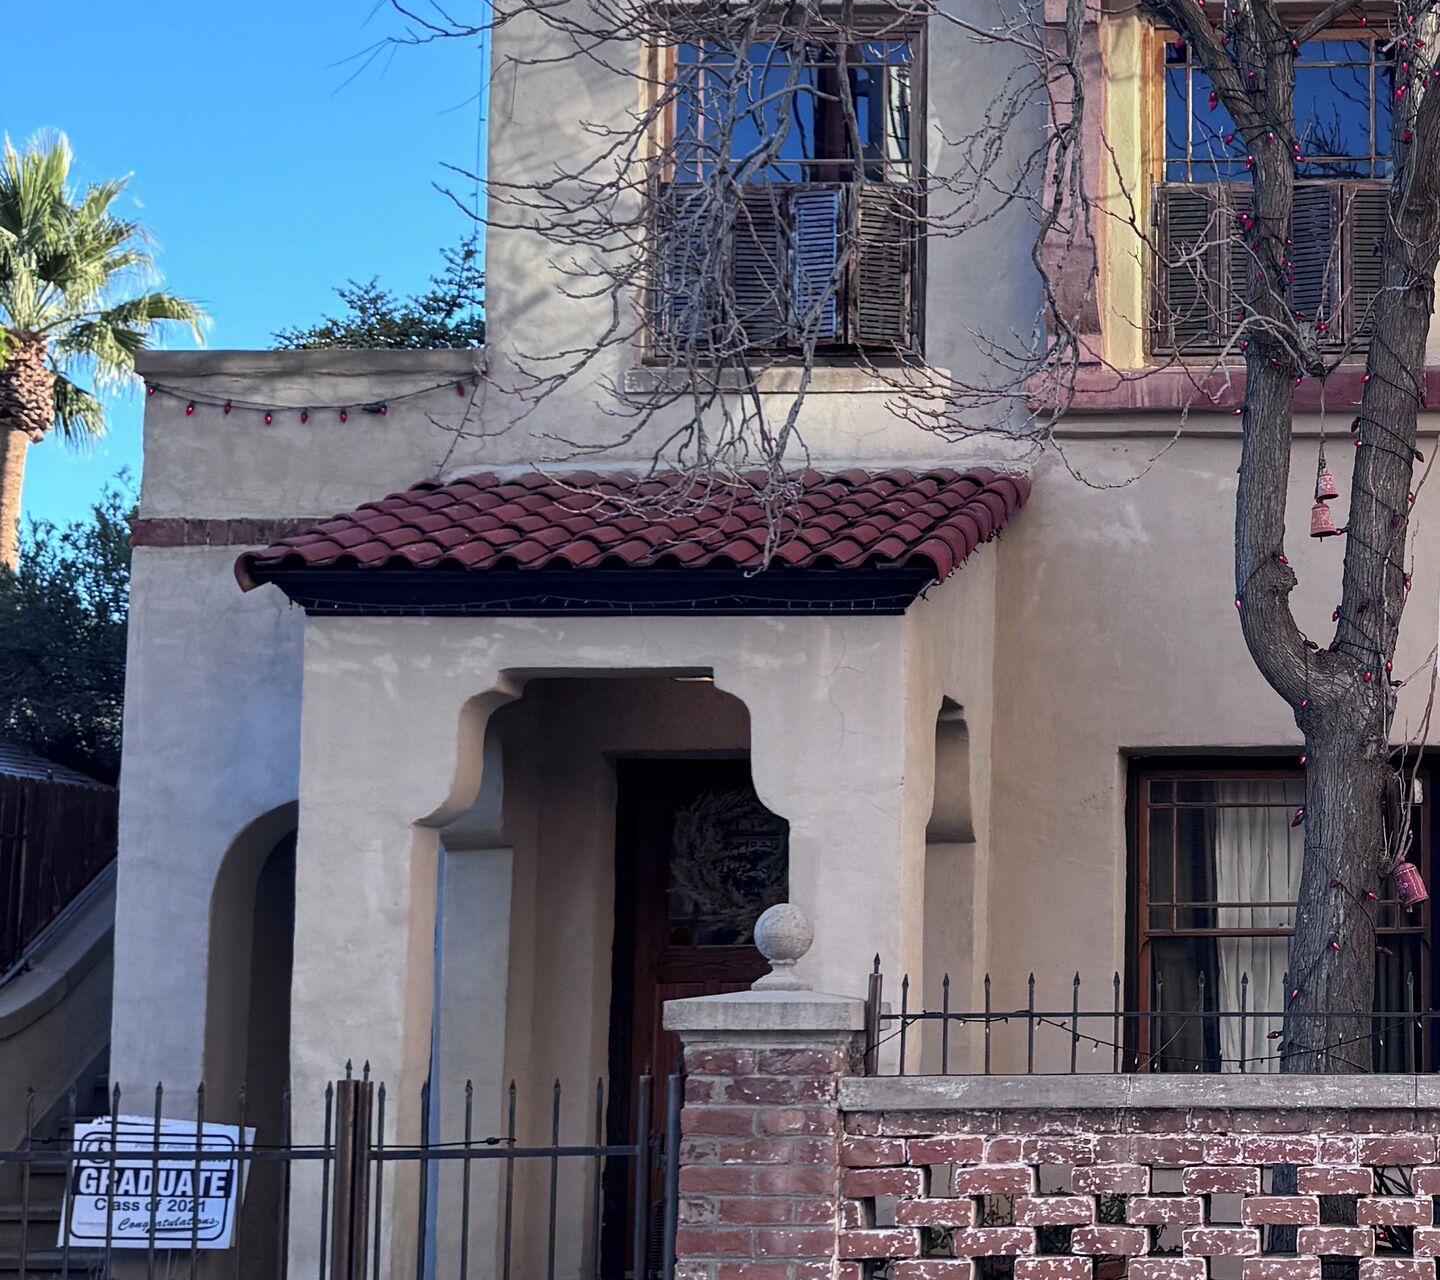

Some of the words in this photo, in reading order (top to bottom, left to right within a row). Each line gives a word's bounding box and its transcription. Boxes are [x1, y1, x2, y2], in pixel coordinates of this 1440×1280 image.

[79, 1167, 226, 1197] GRADUATE
[94, 1197, 140, 1212] Cass
[167, 1199, 206, 1213] 2021
